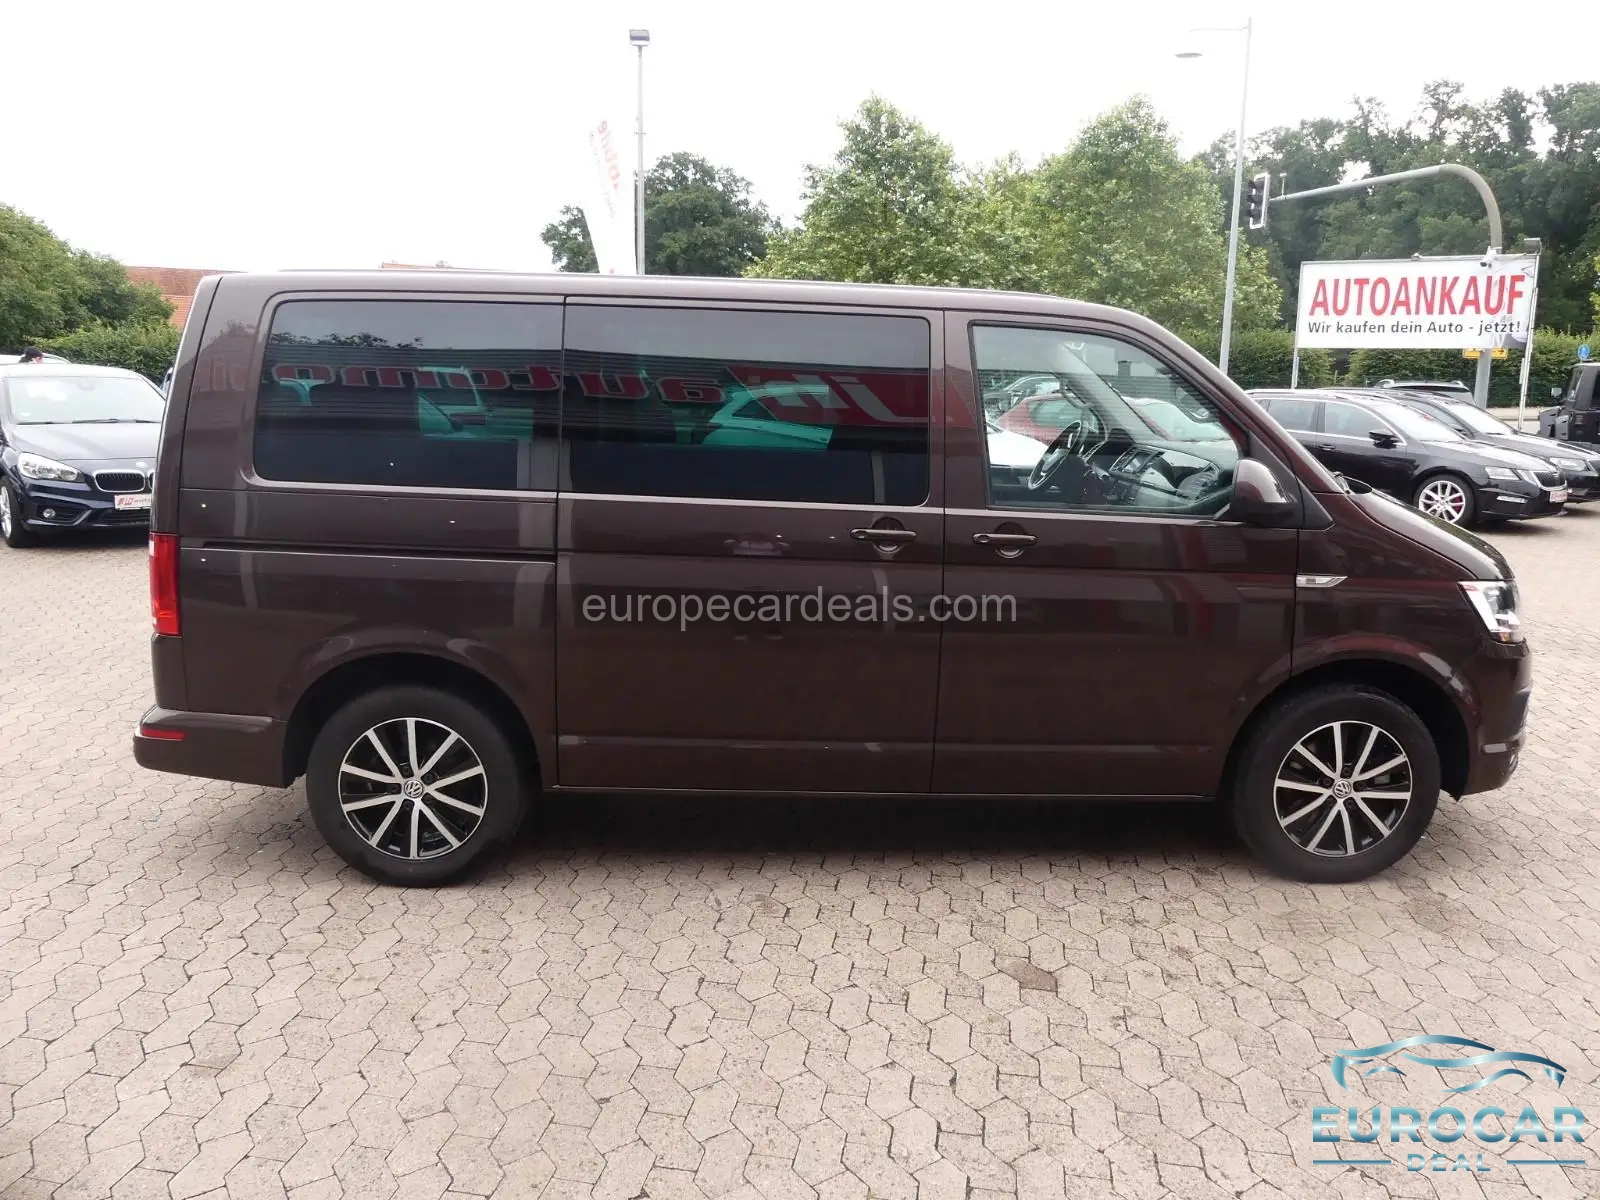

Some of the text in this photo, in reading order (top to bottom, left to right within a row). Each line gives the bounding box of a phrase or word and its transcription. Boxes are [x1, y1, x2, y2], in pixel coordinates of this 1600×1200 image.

[1309, 275, 1525, 316] AUTOANKAUF
[1308, 321, 1332, 333] Wir
[1336, 320, 1386, 333] kaufen
[1391, 320, 1423, 333] dein
[1427, 321, 1463, 333] Auto
[1478, 320, 1521, 336] jetzt!
